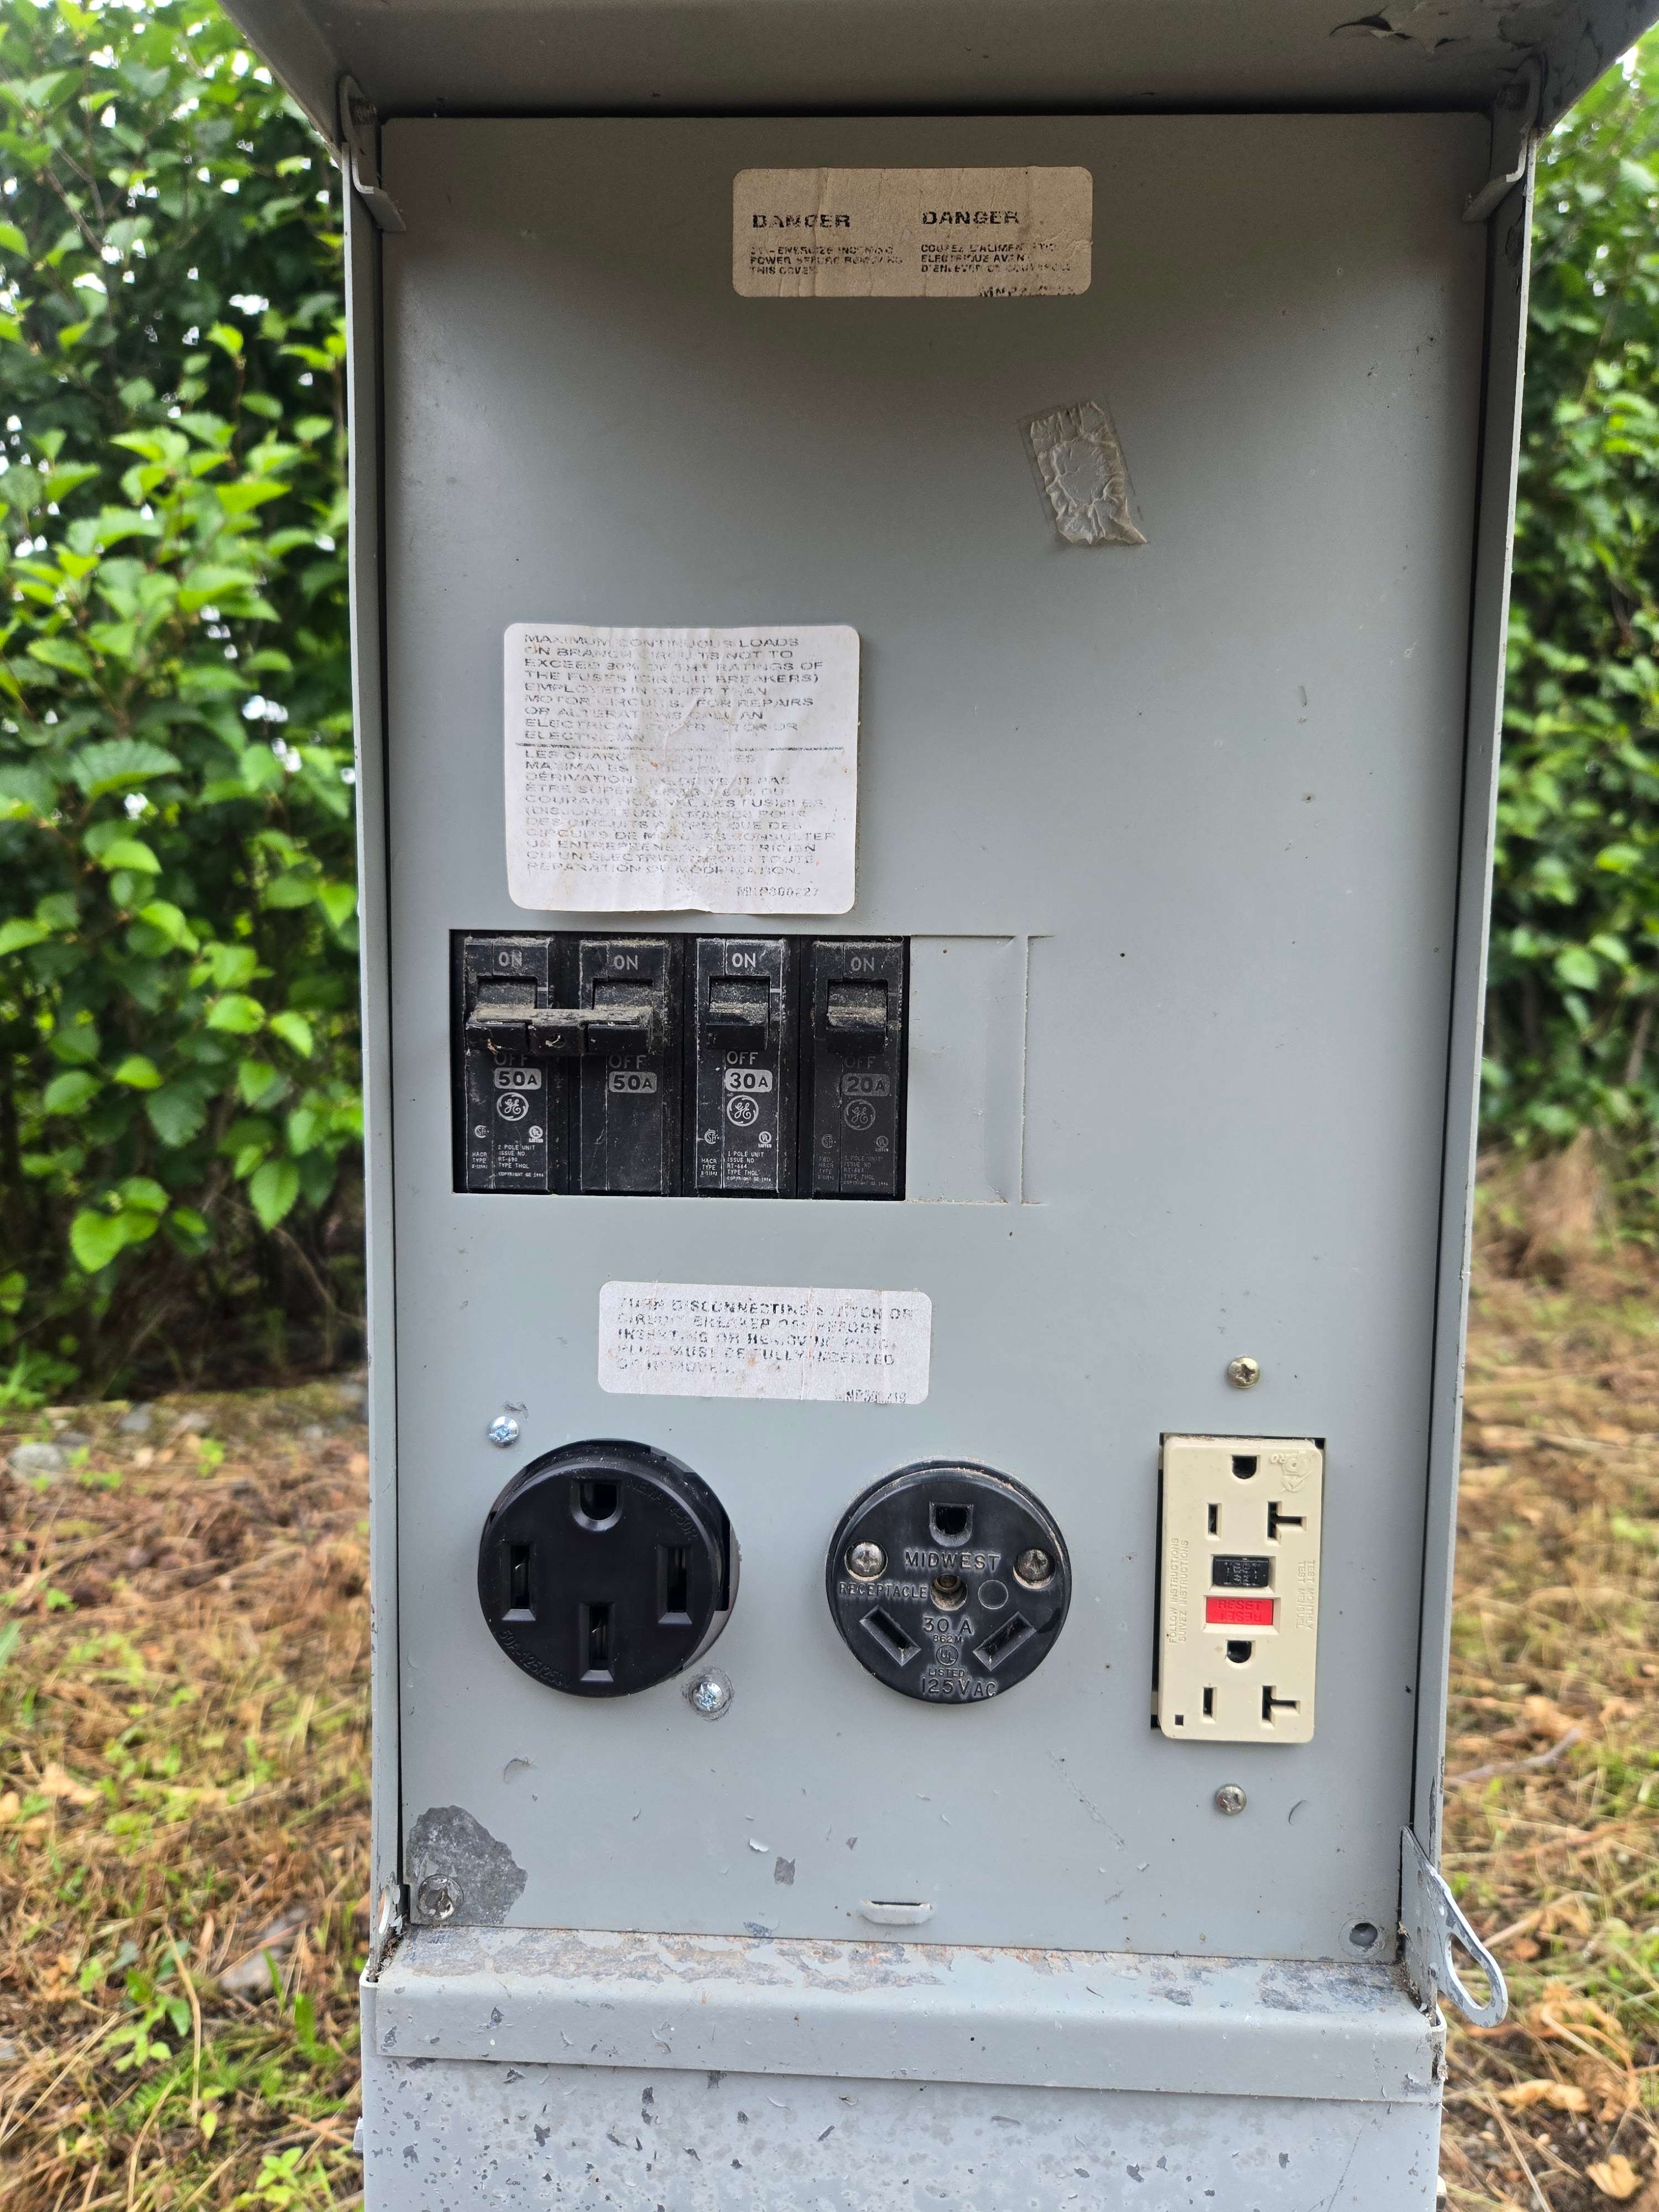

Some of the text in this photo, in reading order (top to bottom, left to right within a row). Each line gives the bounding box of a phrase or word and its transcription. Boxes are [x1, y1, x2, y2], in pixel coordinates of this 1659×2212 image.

[753, 214, 850, 227] DANGER
[922, 211, 1019, 224] DANGER
[739, 638, 800, 648] LOADS
[525, 646, 550, 655] ON
[638, 649, 719, 660] CIRCUTS
[726, 650, 763, 660] NOT
[768, 650, 794, 659] TO
[525, 658, 601, 670] EXCEED
[800, 661, 824, 670] OF
[525, 670, 560, 681] THE
[568, 672, 627, 683] FUSES
[721, 687, 767, 696] TAN
[525, 706, 550, 716] OR
[525, 761, 629, 773] MAIMALES
[499, 950, 522, 967] ON
[614, 955, 638, 970] ON
[732, 953, 756, 967] ON
[851, 957, 874, 972] ON
[609, 1055, 646, 1069] OFF
[727, 1051, 758, 1065] OFF
[844, 1056, 875, 1069] OFF
[499, 1071, 538, 1087] 50A
[613, 1074, 653, 1090] 50A
[730, 1072, 768, 1089] 30A
[846, 1077, 885, 1093] 20A
[905, 1551, 1000, 1571] MIDWEST
[1298, 1561, 1306, 1584] TEST
[838, 1581, 928, 1599] RECEPTACLE
[1169, 1537, 1179, 1644] FOLLOW INSTRUCTIONS
[1178, 1540, 1189, 1642] SUIVEZ INSTRUCTIONS
[1306, 1588, 1314, 1630] MONTHLY
[928, 1667, 966, 1677] LISTED
